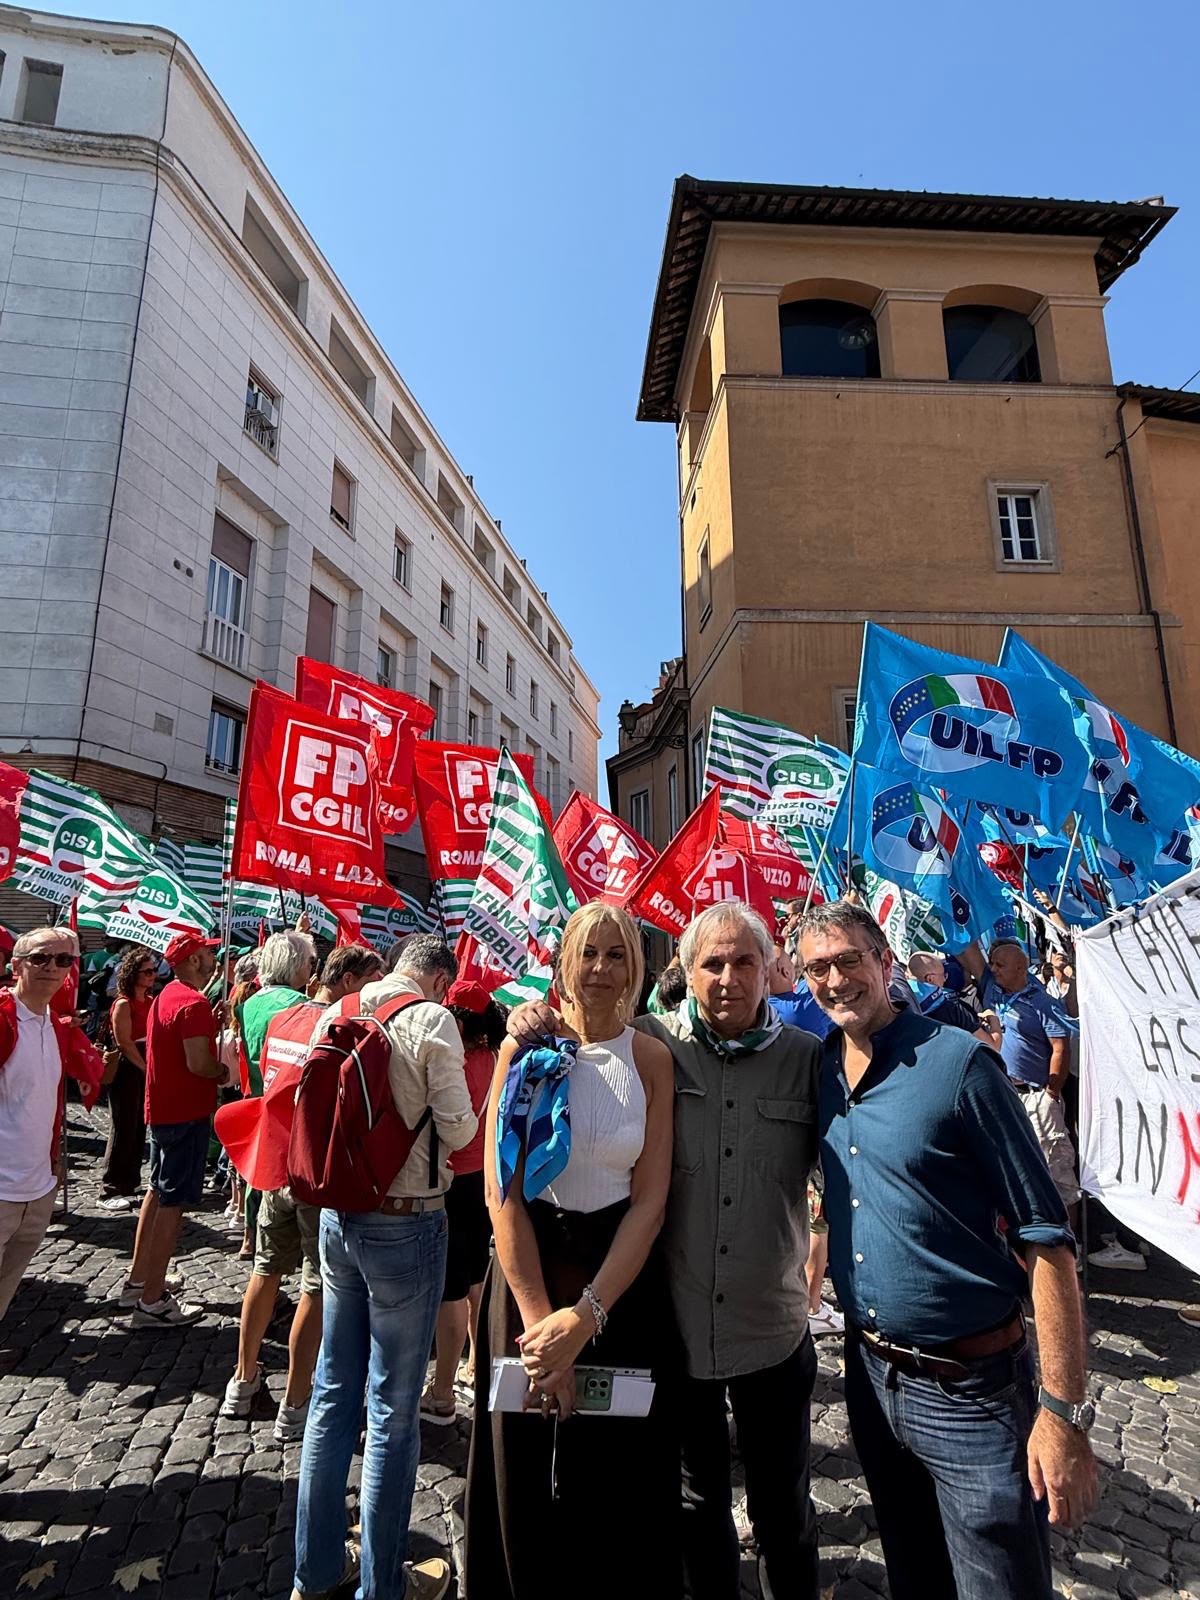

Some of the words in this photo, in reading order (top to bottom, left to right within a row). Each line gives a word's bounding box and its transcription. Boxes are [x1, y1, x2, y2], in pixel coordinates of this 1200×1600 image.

[294, 735, 367, 797] FP
[773, 769, 826, 787] CISL
[290, 792, 367, 837] CGIL
[60, 830, 99, 855] CISL
[255, 840, 311, 876] ROMA
[577, 850, 628, 889] CGIL
[31, 867, 91, 897] FUNZIONE
[137, 886, 174, 906] CISL
[392, 912, 415, 924] CISL
[648, 890, 689, 929] ROM
[107, 926, 164, 951] PUBBLICA
[111, 915, 174, 943] FUNZIONE
